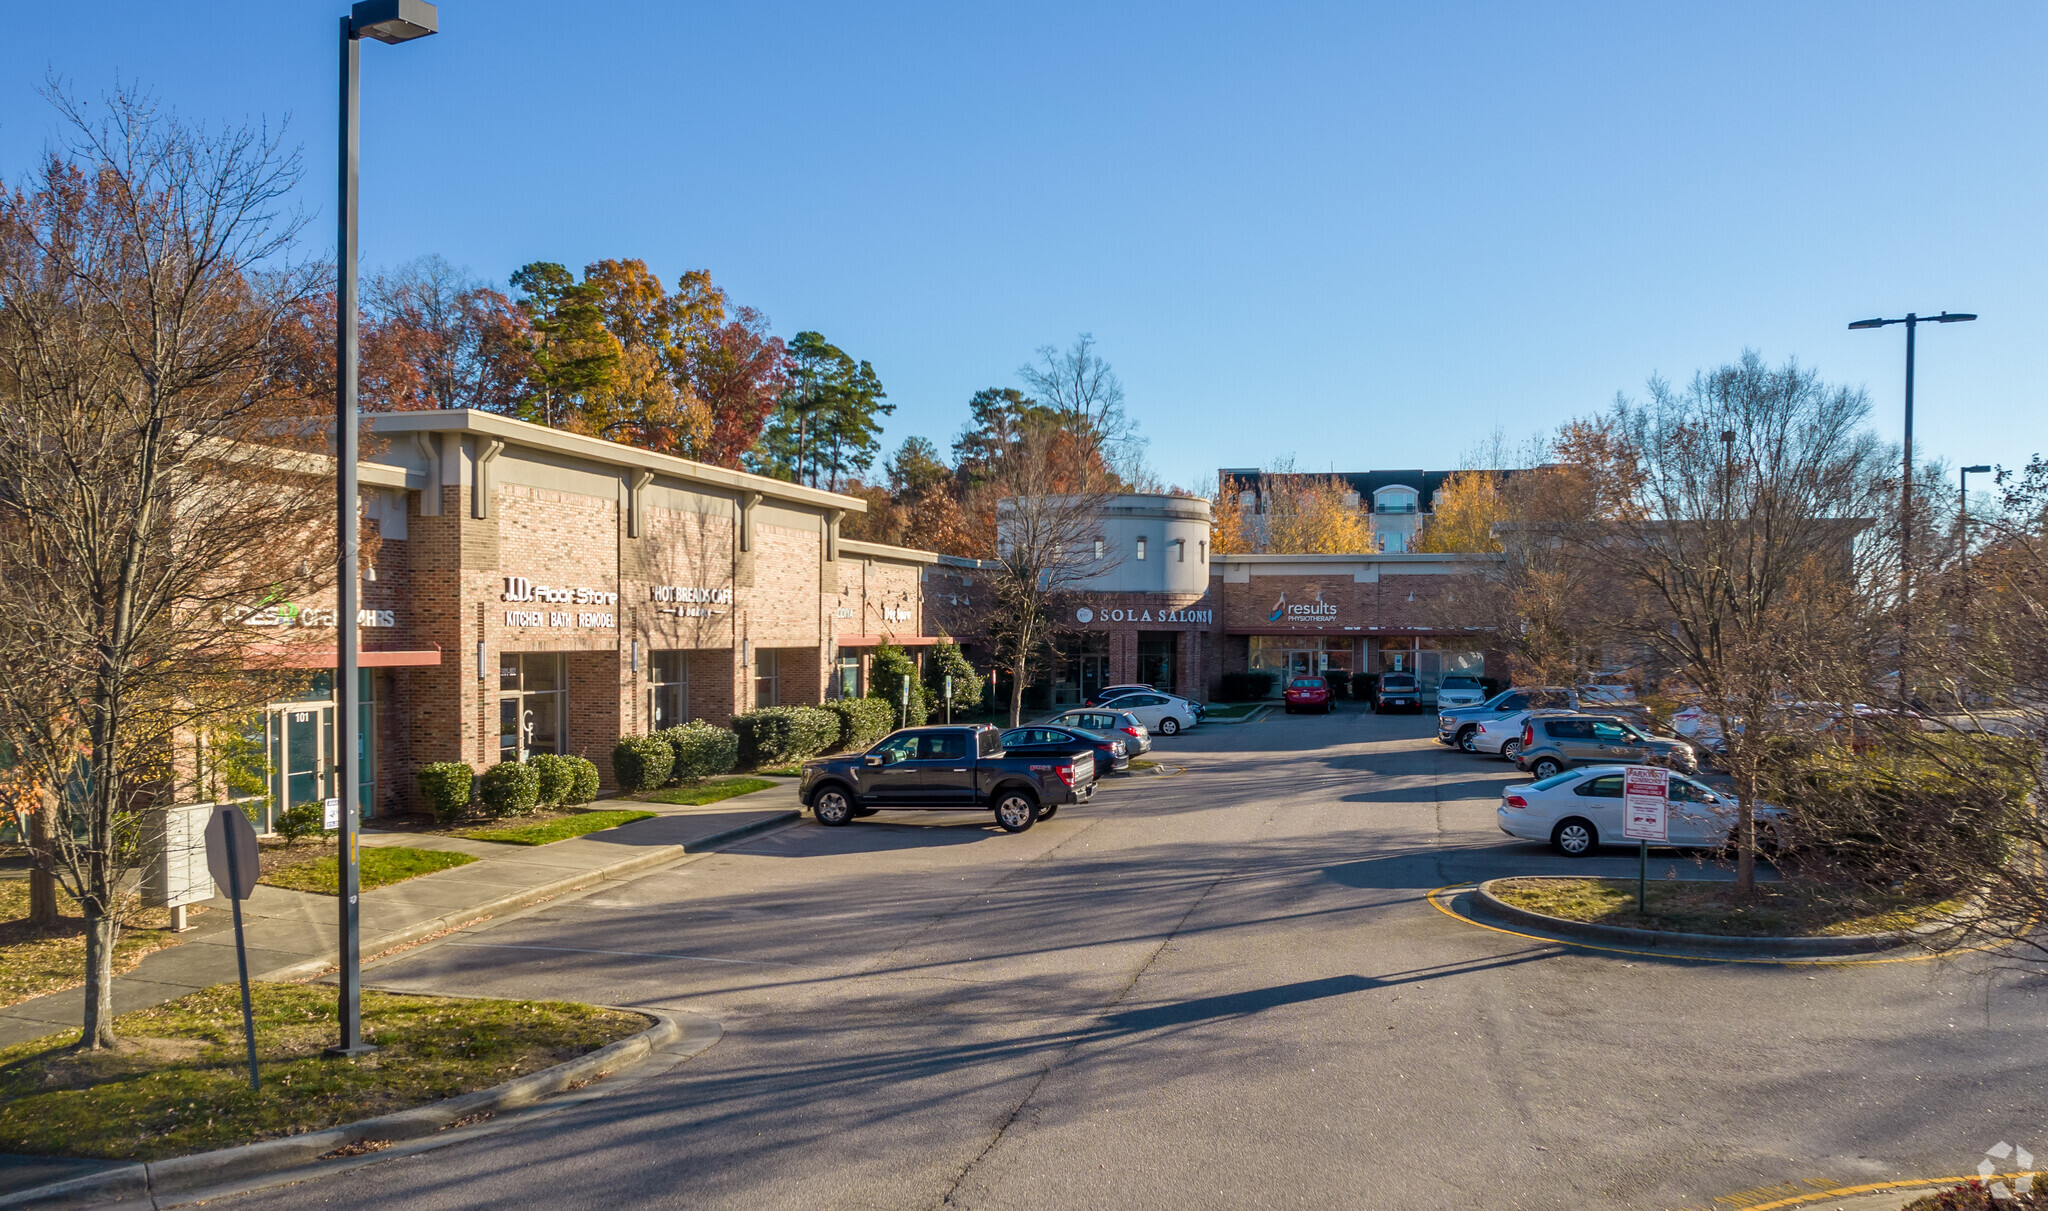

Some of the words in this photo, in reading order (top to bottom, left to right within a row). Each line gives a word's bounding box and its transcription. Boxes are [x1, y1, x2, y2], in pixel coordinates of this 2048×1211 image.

[535, 585, 575, 602] Floor
[577, 587, 618, 605] Store
[654, 585, 674, 602] HOT
[675, 586, 711, 603] BREADS
[1100, 609, 1152, 622] SOLA
[1158, 609, 1208, 623] SALONS
[1288, 600, 1337, 615] results
[357, 609, 395, 627] 4HRS
[506, 611, 543, 627] KITCHEN
[550, 612, 571, 627] BATH
[578, 613, 615, 628] REMODEL
[294, 712, 309, 723] 101
